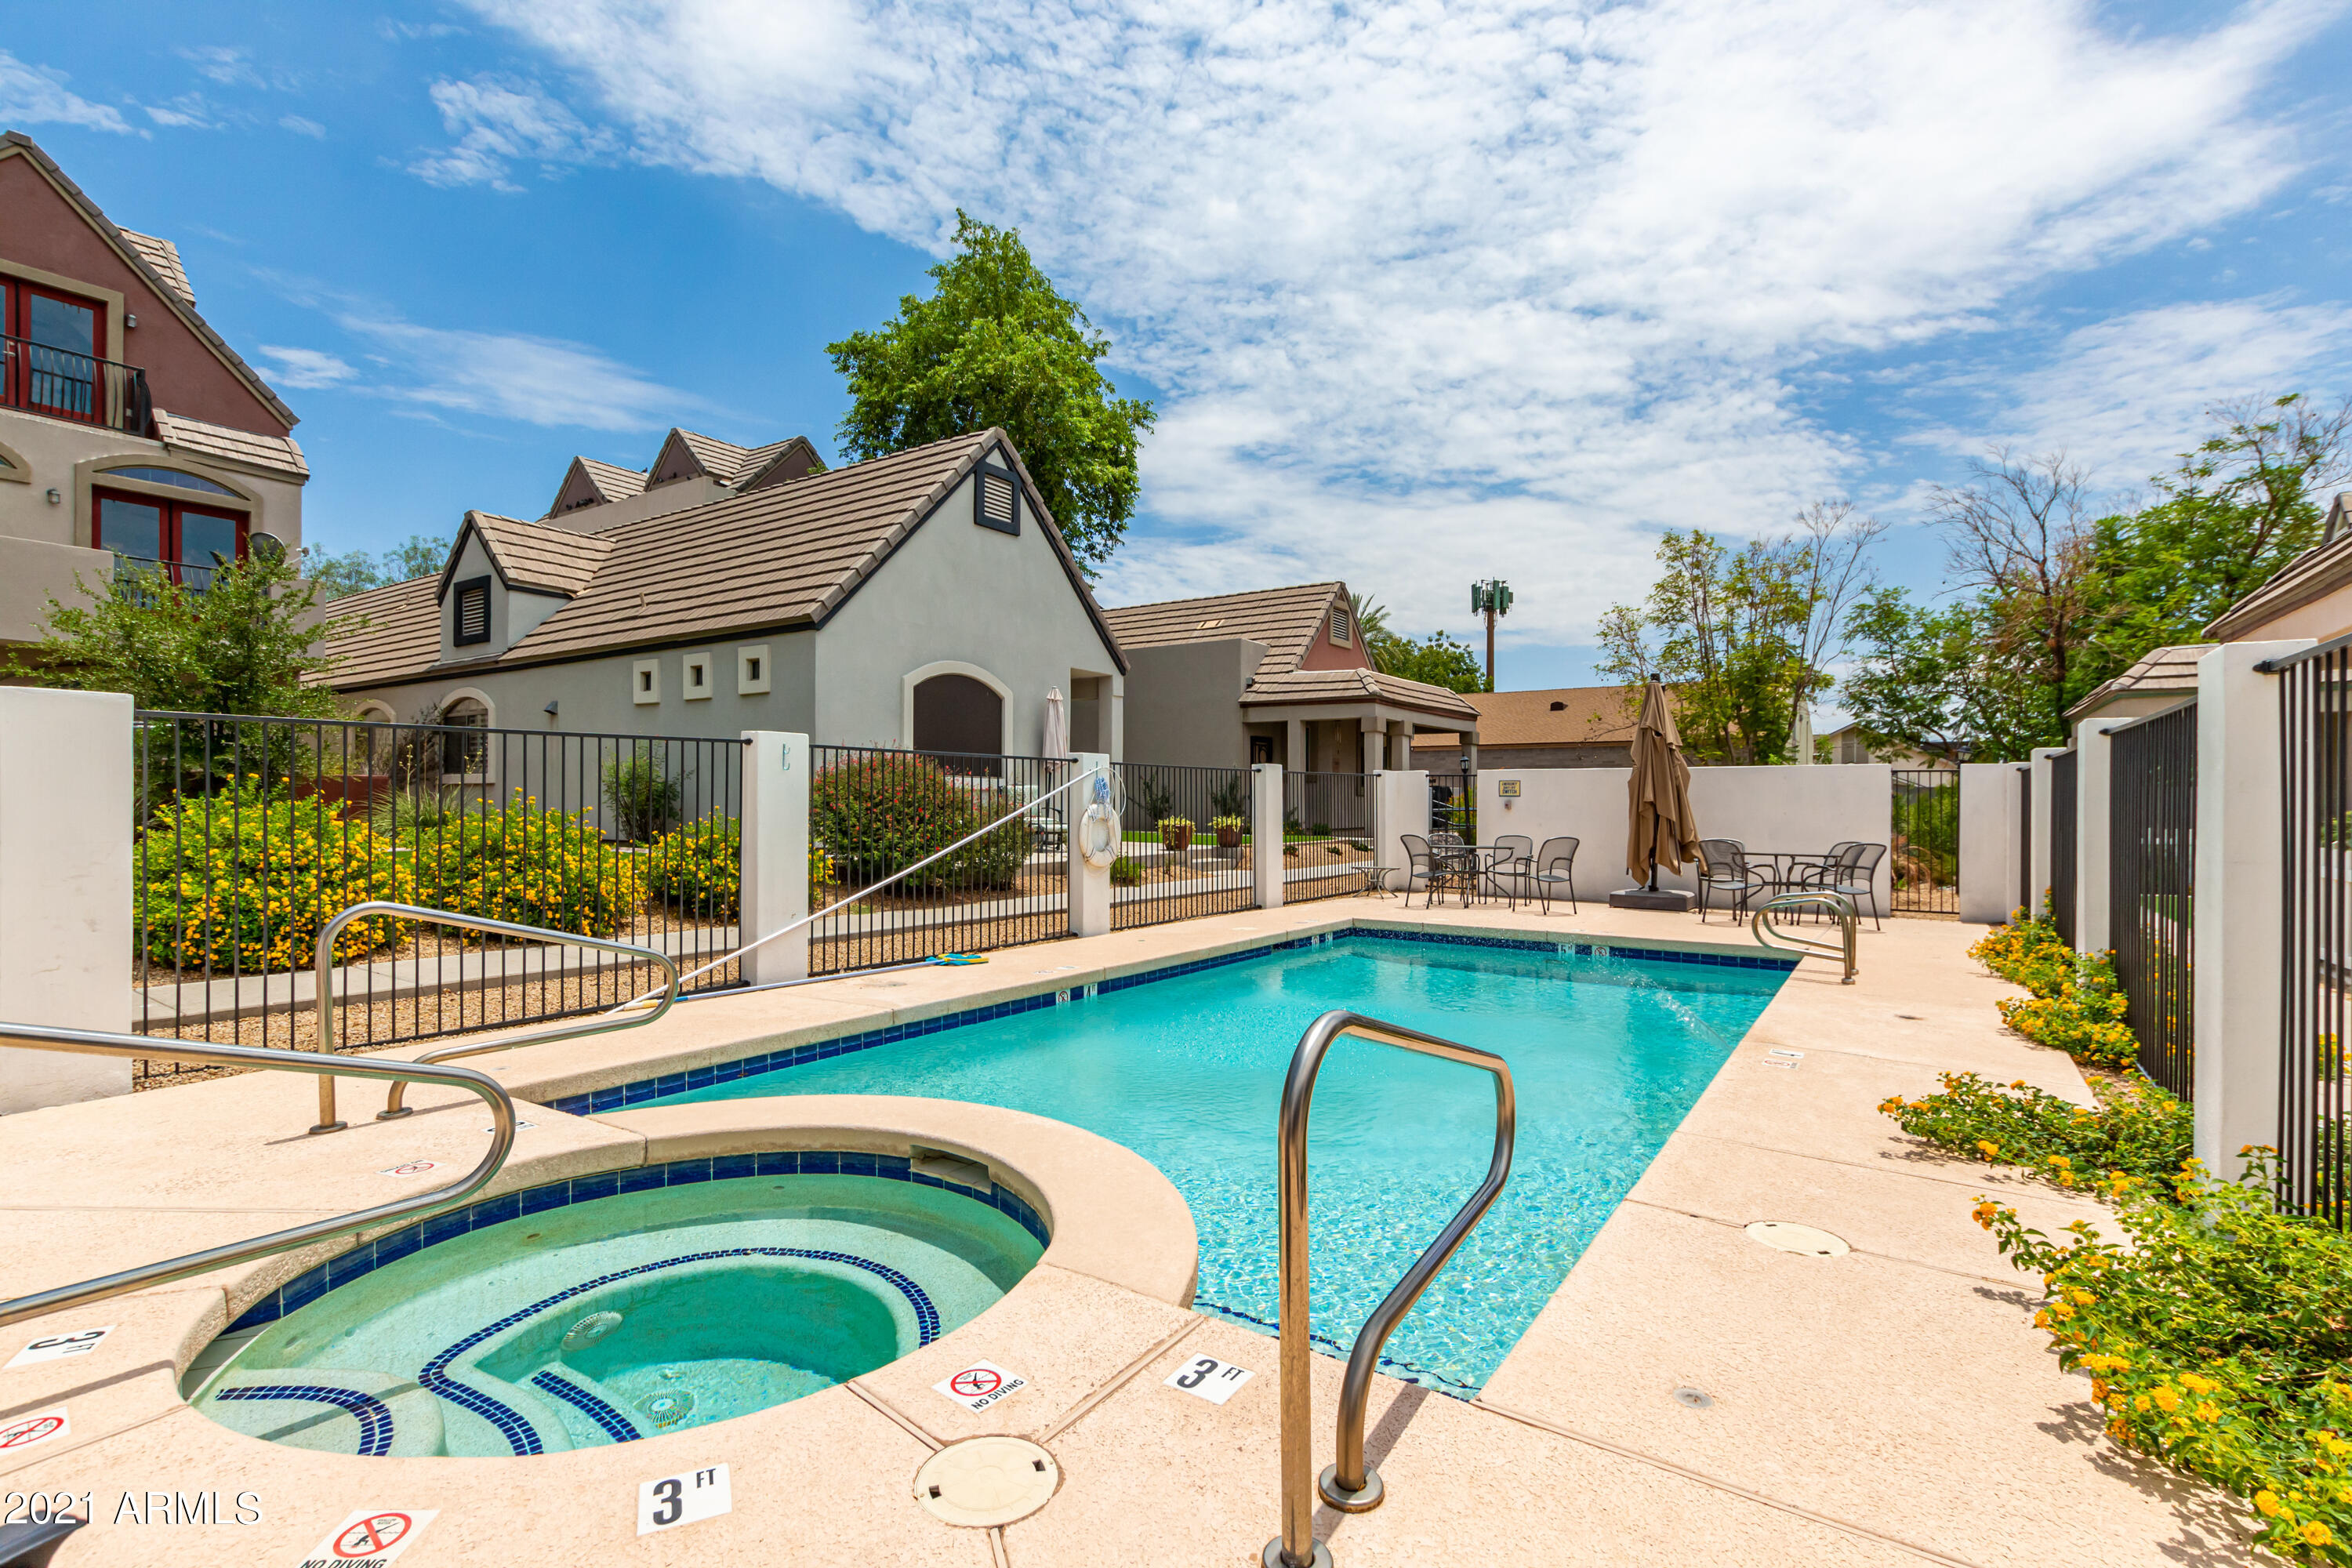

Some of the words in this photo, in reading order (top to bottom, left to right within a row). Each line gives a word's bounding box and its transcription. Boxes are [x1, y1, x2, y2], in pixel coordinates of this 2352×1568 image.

[27, 1331, 106, 1349] 3
[1177, 1359, 1219, 1388] 3
[1221, 1367, 1245, 1381] FT
[971, 1399, 989, 1410] NO
[988, 1379, 1024, 1401] DIVING
[652, 1479, 683, 1526] 3
[696, 1468, 717, 1489] FT
